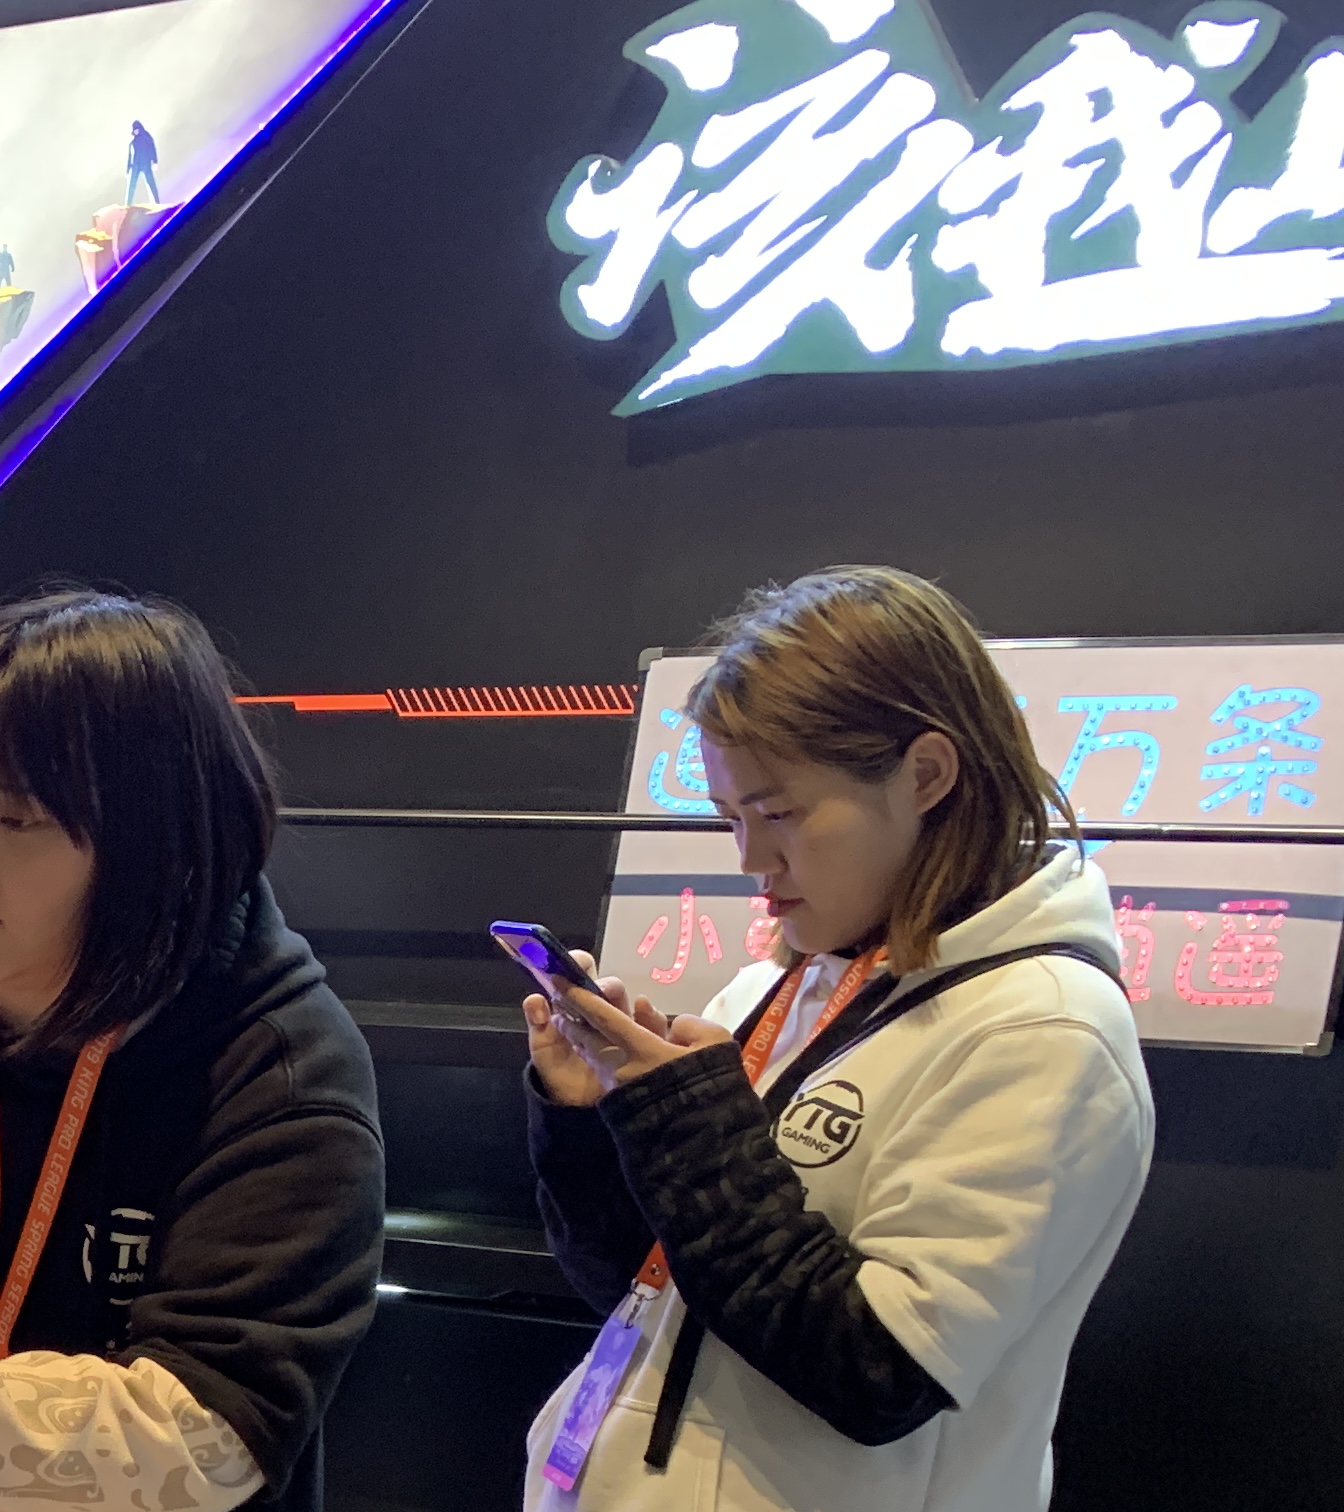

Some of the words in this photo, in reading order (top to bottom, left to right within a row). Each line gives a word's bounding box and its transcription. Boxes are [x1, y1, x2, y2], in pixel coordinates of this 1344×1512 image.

[753, 1020, 777, 1051] PRO
[70, 1066, 95, 1110] KING
[58, 1113, 79, 1150] PRO
[781, 1126, 832, 1155] GAMING
[37, 1152, 67, 1217] LEAGUE
[16, 1219, 46, 1281] SPRING
[109, 1271, 145, 1284] AMIN
